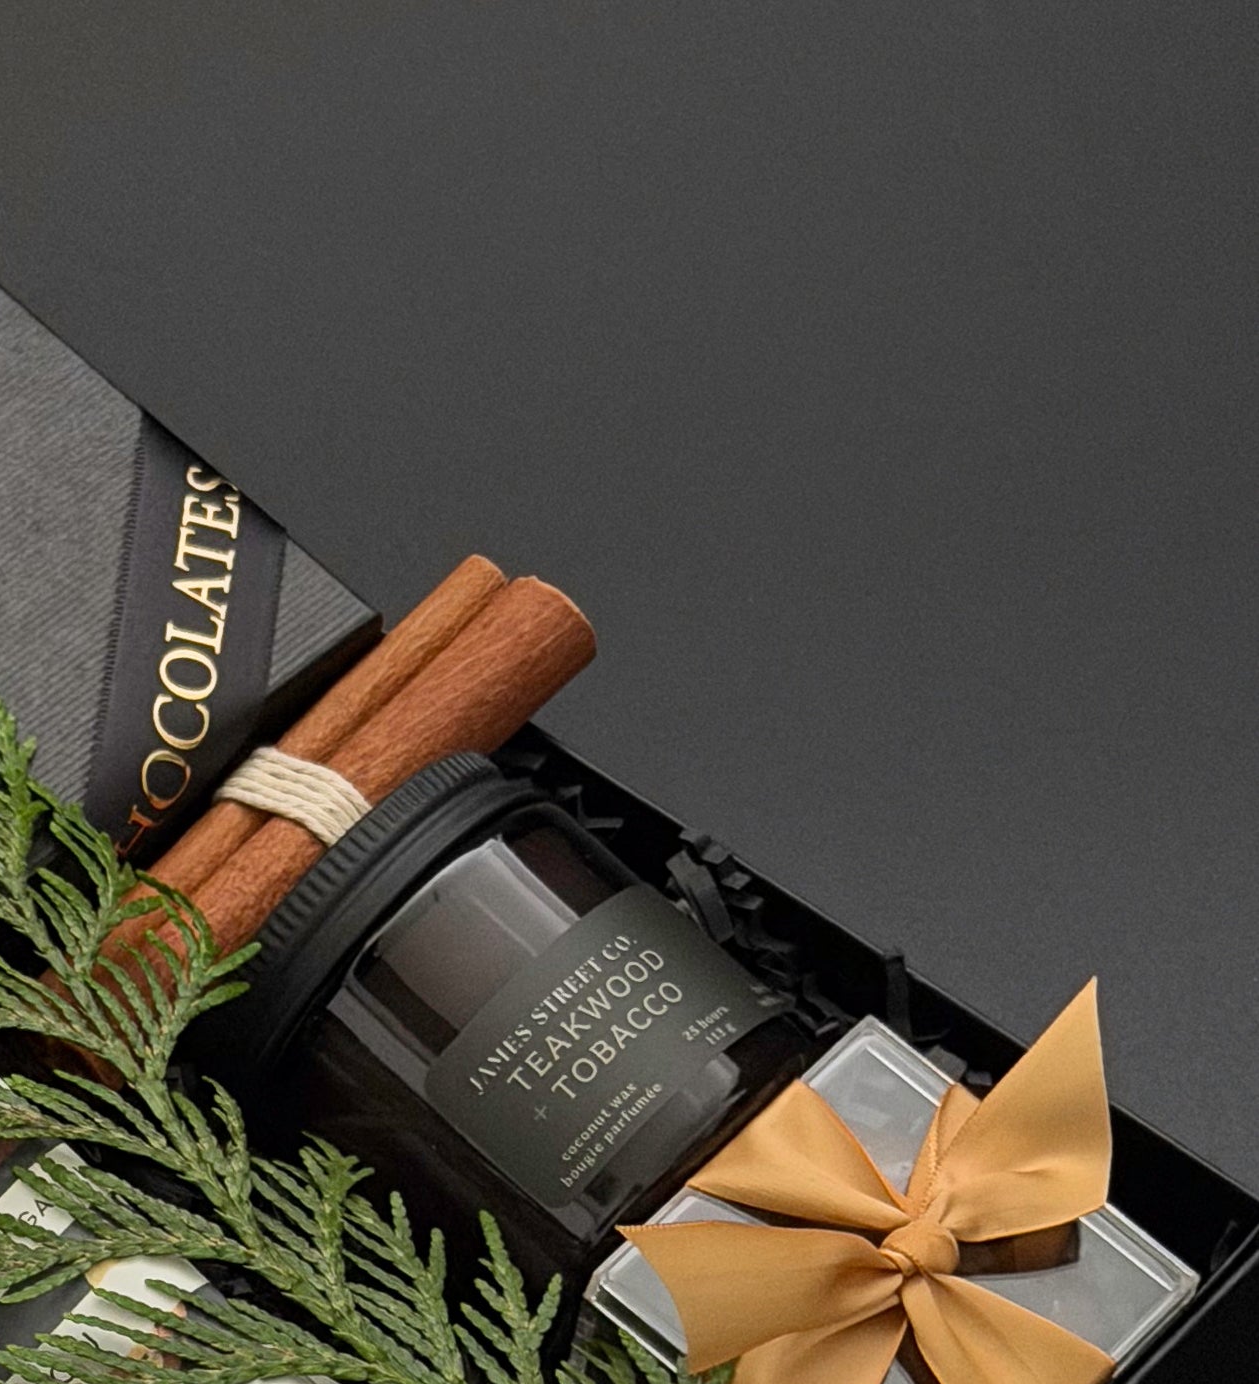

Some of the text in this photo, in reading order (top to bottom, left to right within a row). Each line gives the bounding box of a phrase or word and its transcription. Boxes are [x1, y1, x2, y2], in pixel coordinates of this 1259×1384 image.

[115, 465, 240, 858] HOCOLATES
[470, 934, 638, 1096] JAMES STREET CO.
[507, 949, 664, 1091] TEAKWOOD
[551, 982, 683, 1100] TOBACCO
[560, 1082, 663, 1188] bougie parfumée
[561, 1081, 638, 1162] coconut wax
